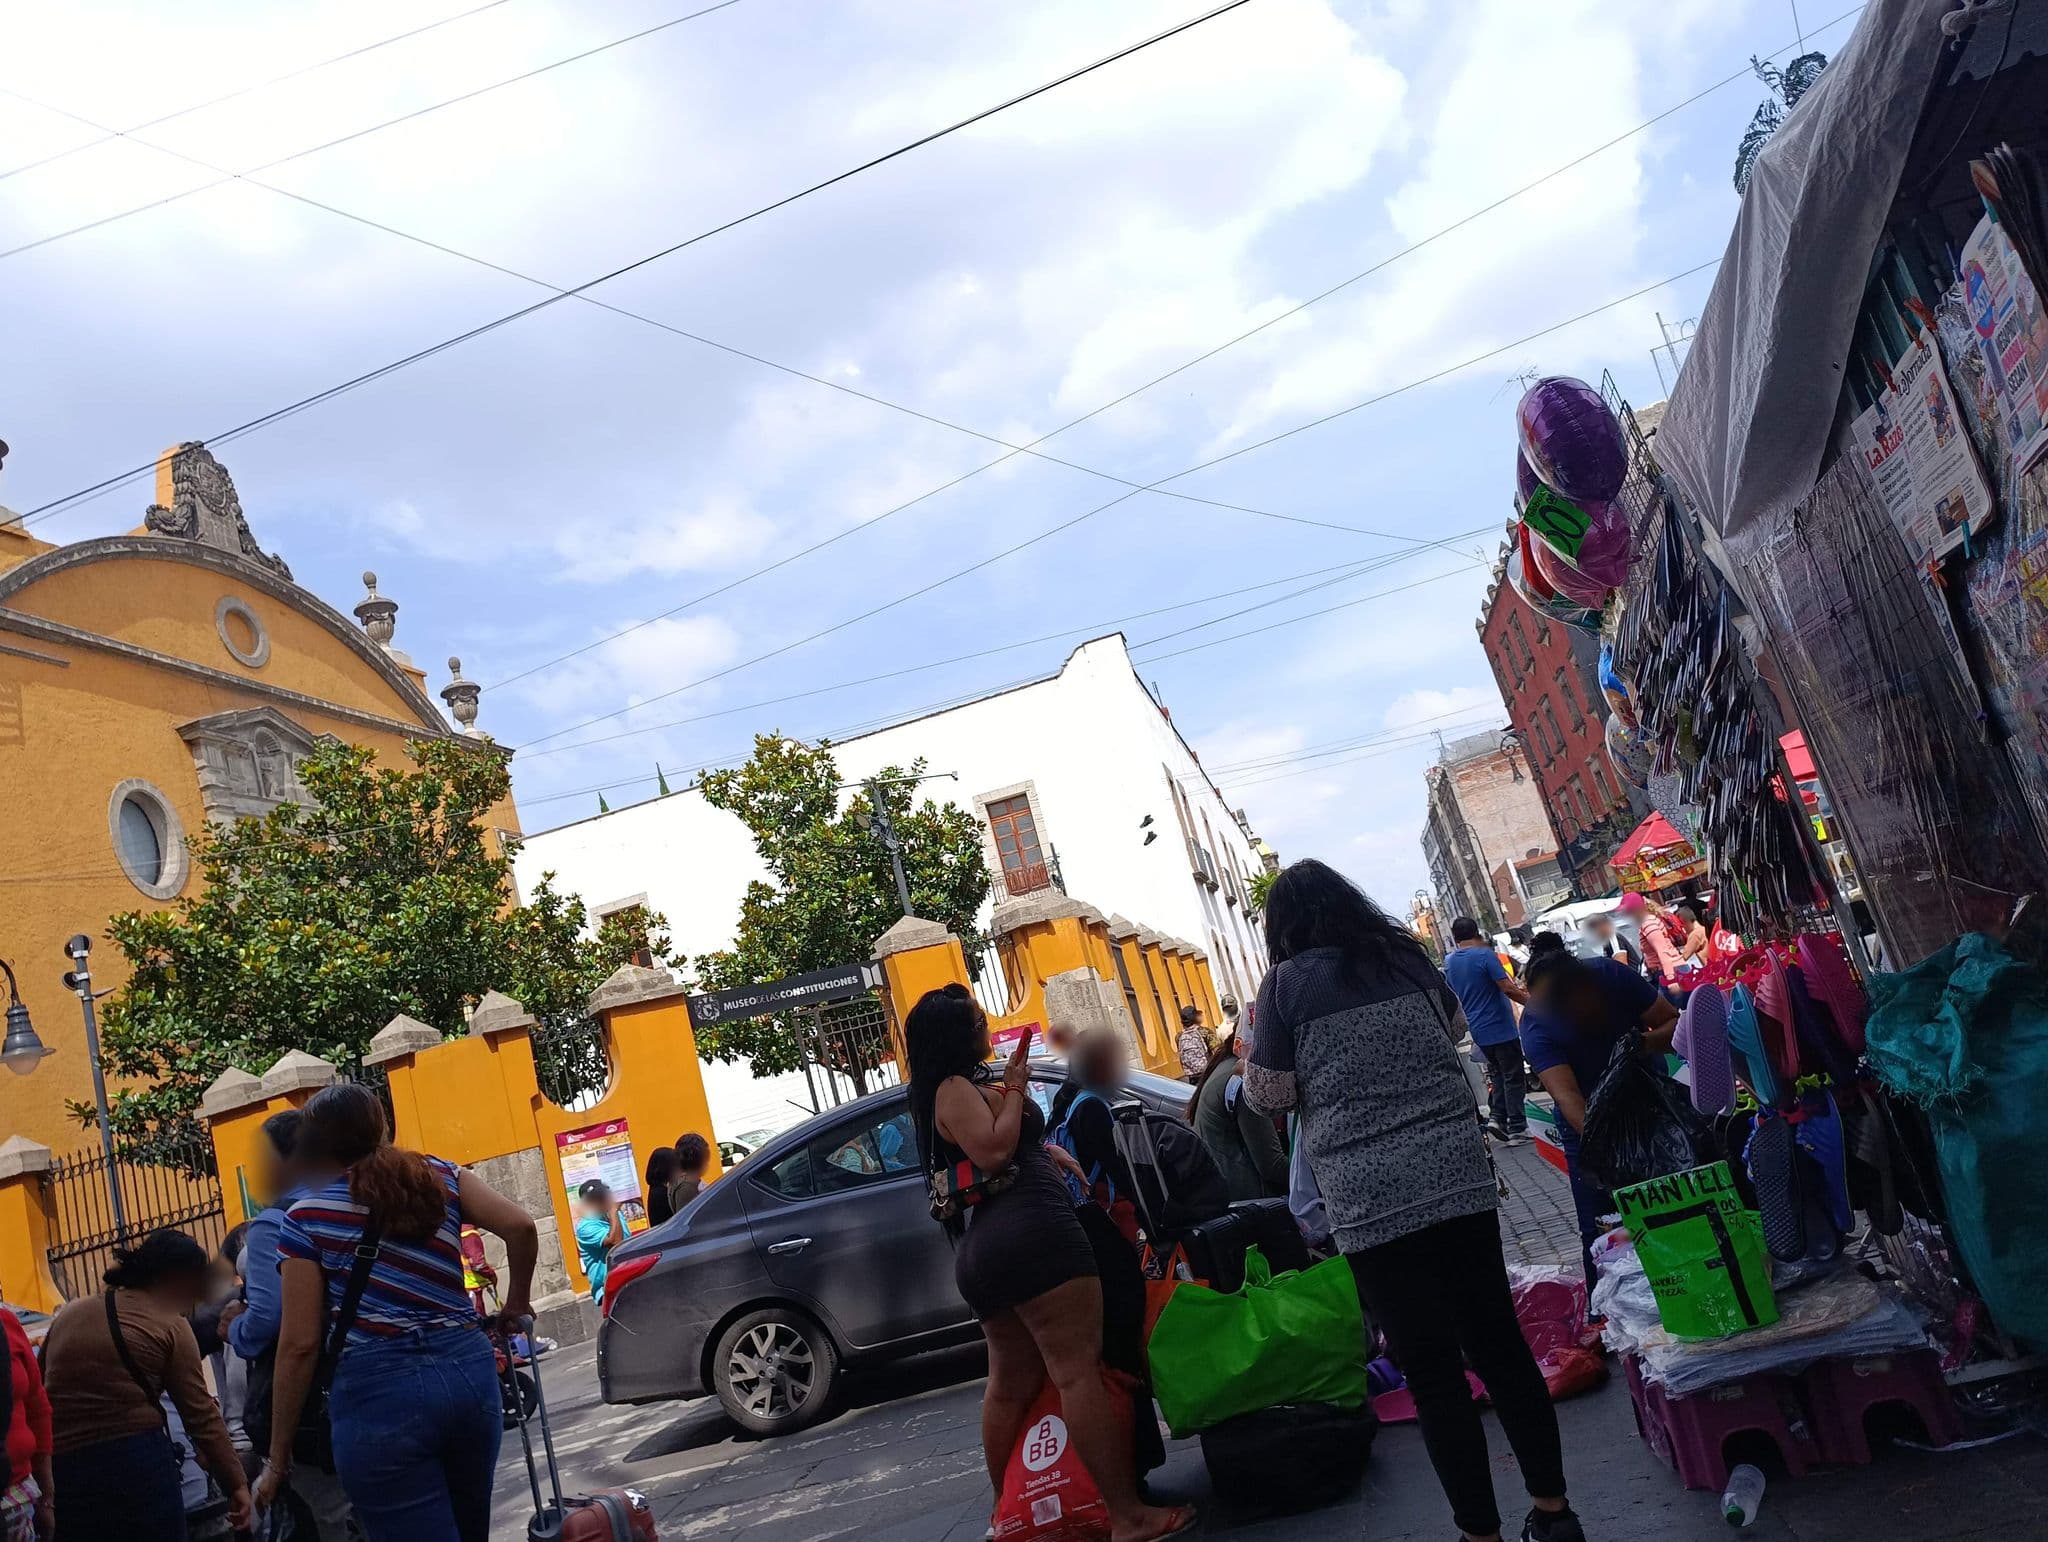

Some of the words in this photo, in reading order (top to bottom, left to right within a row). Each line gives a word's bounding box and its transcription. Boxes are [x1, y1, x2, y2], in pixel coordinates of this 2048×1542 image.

[1864, 447, 1884, 470] La
[723, 996, 757, 1011] MUSEO
[780, 975, 858, 999] CONSTITUCIONES
[582, 1138, 608, 1151] Agosto
[1617, 1165, 1735, 1215] MANTEL
[1038, 1420, 1051, 1441] B
[1025, 1475, 1051, 1490] Tiendas
[1051, 1470, 1061, 1480] 3B
